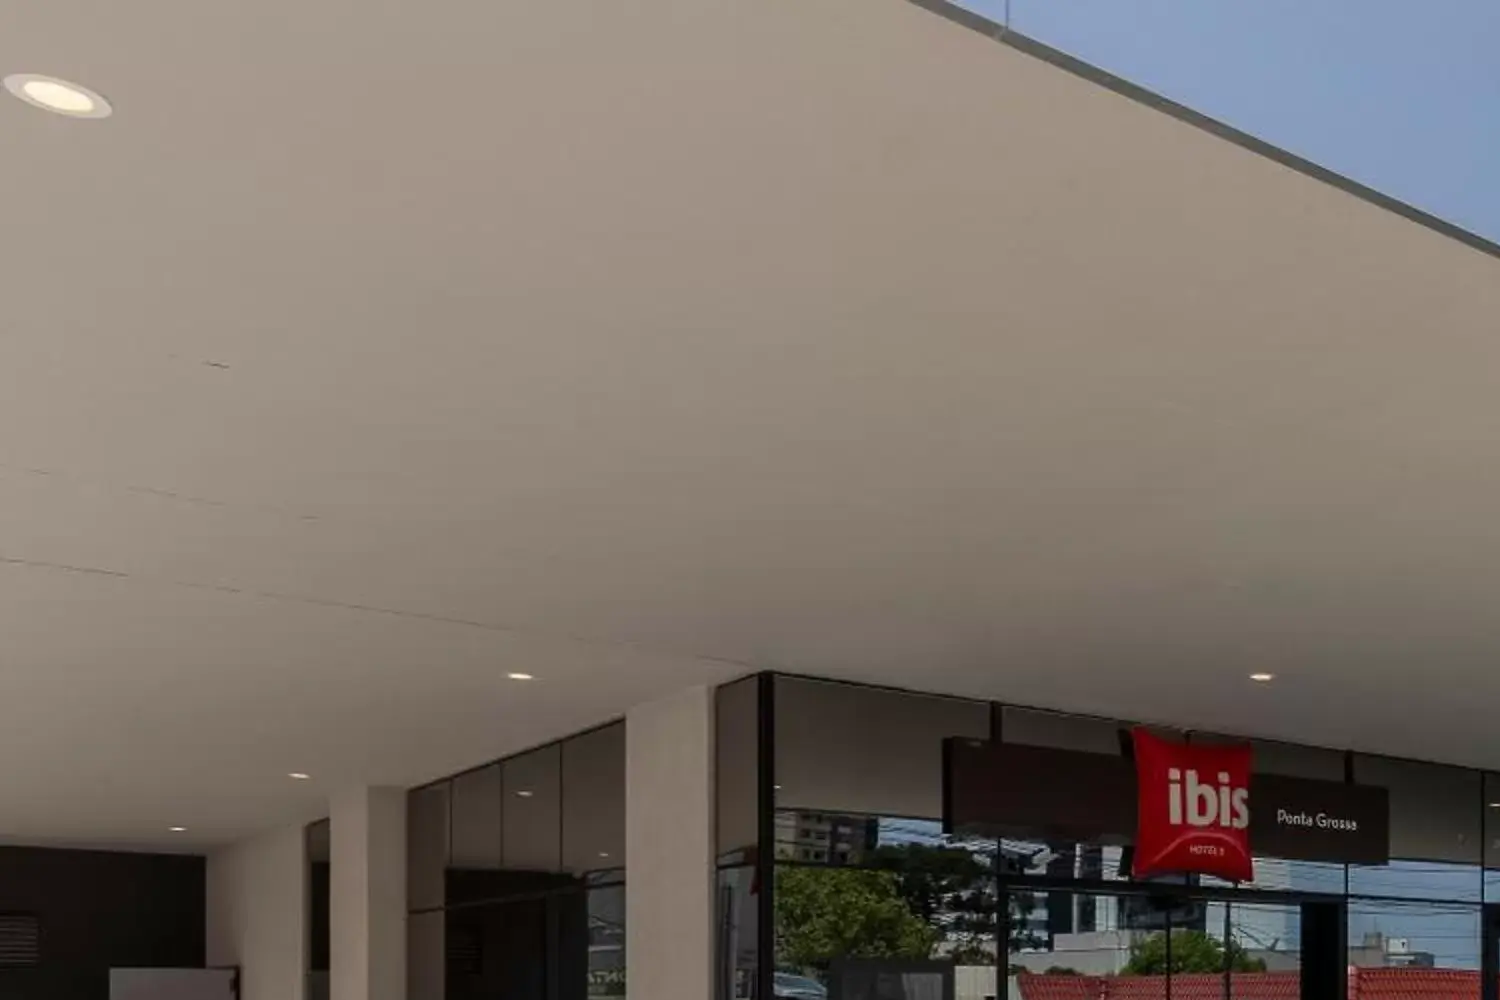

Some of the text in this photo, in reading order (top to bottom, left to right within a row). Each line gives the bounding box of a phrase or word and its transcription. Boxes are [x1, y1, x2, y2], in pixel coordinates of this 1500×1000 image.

[1168, 767, 1249, 829] ibis
[1277, 808, 1357, 831] Ponta Grossa
